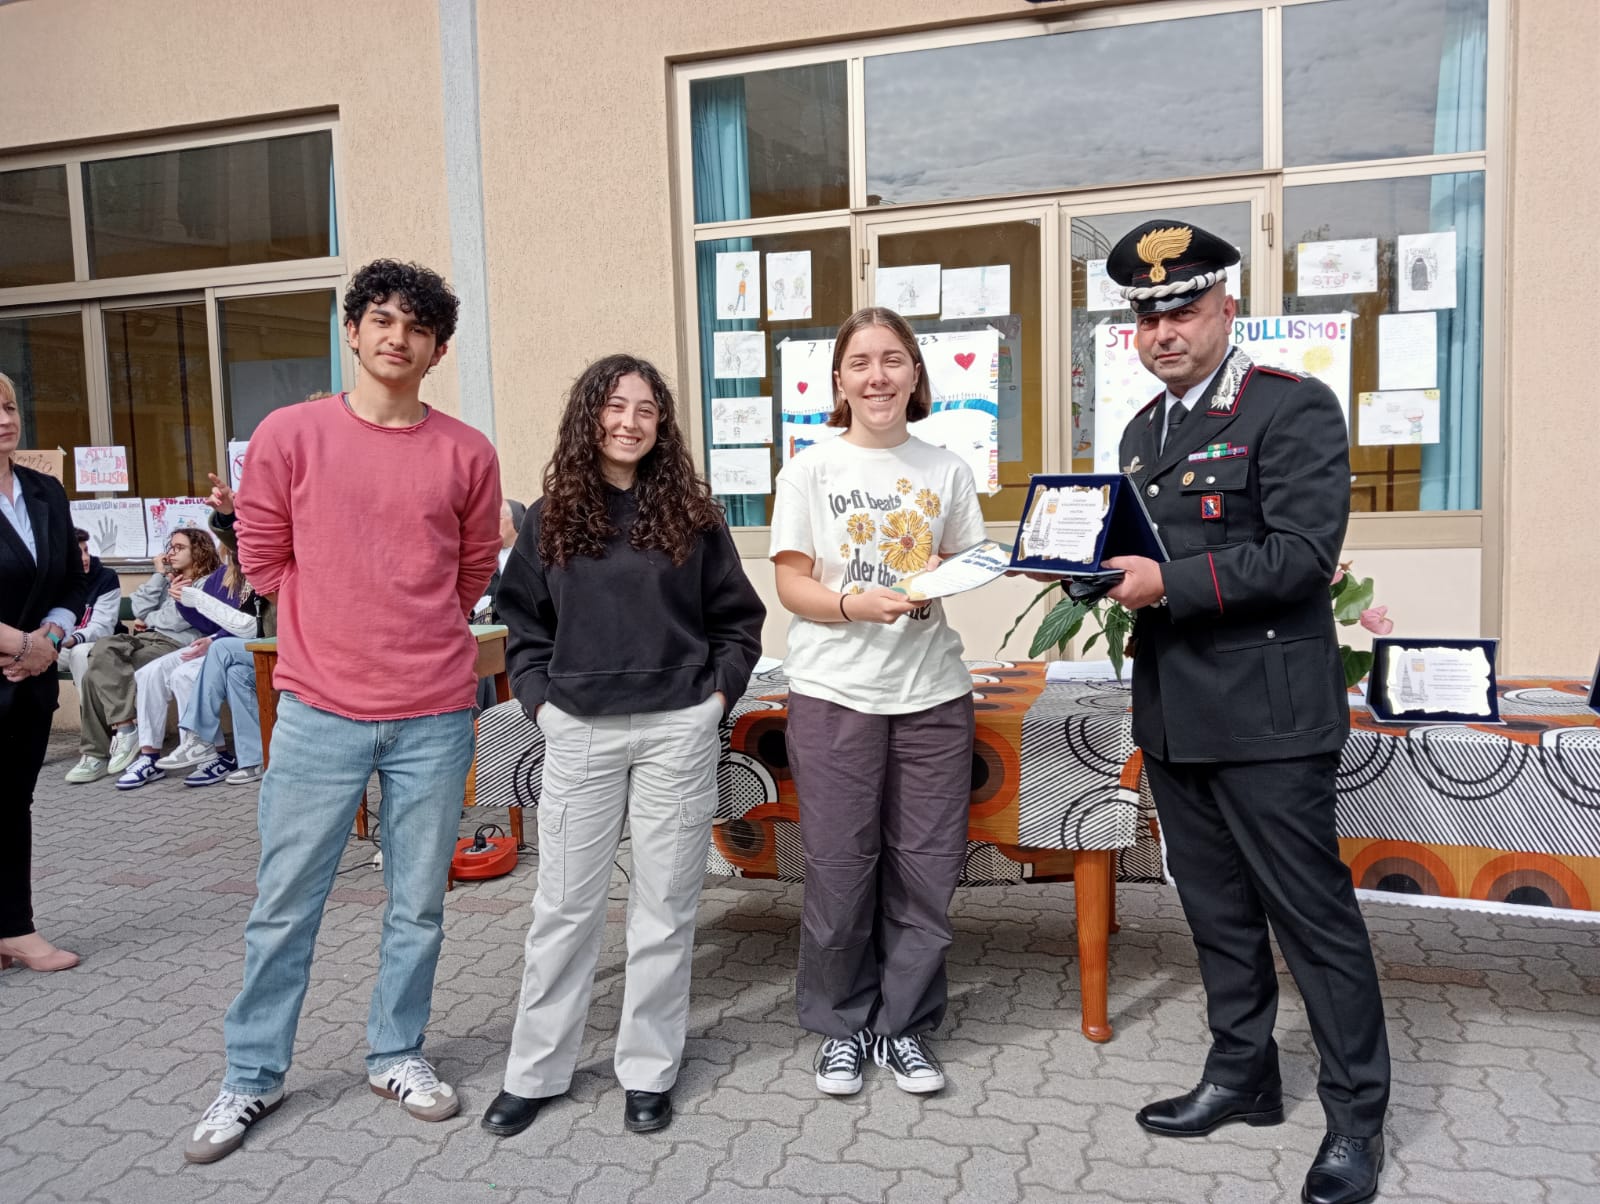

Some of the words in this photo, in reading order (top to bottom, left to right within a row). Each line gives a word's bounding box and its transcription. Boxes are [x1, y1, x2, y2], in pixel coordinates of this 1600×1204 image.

[1106, 325, 1139, 350] ST
[1234, 318, 1346, 344] BULLISMO!
[829, 489, 866, 519] lo-fi
[865, 491, 902, 511] beats
[878, 562, 897, 587] the
